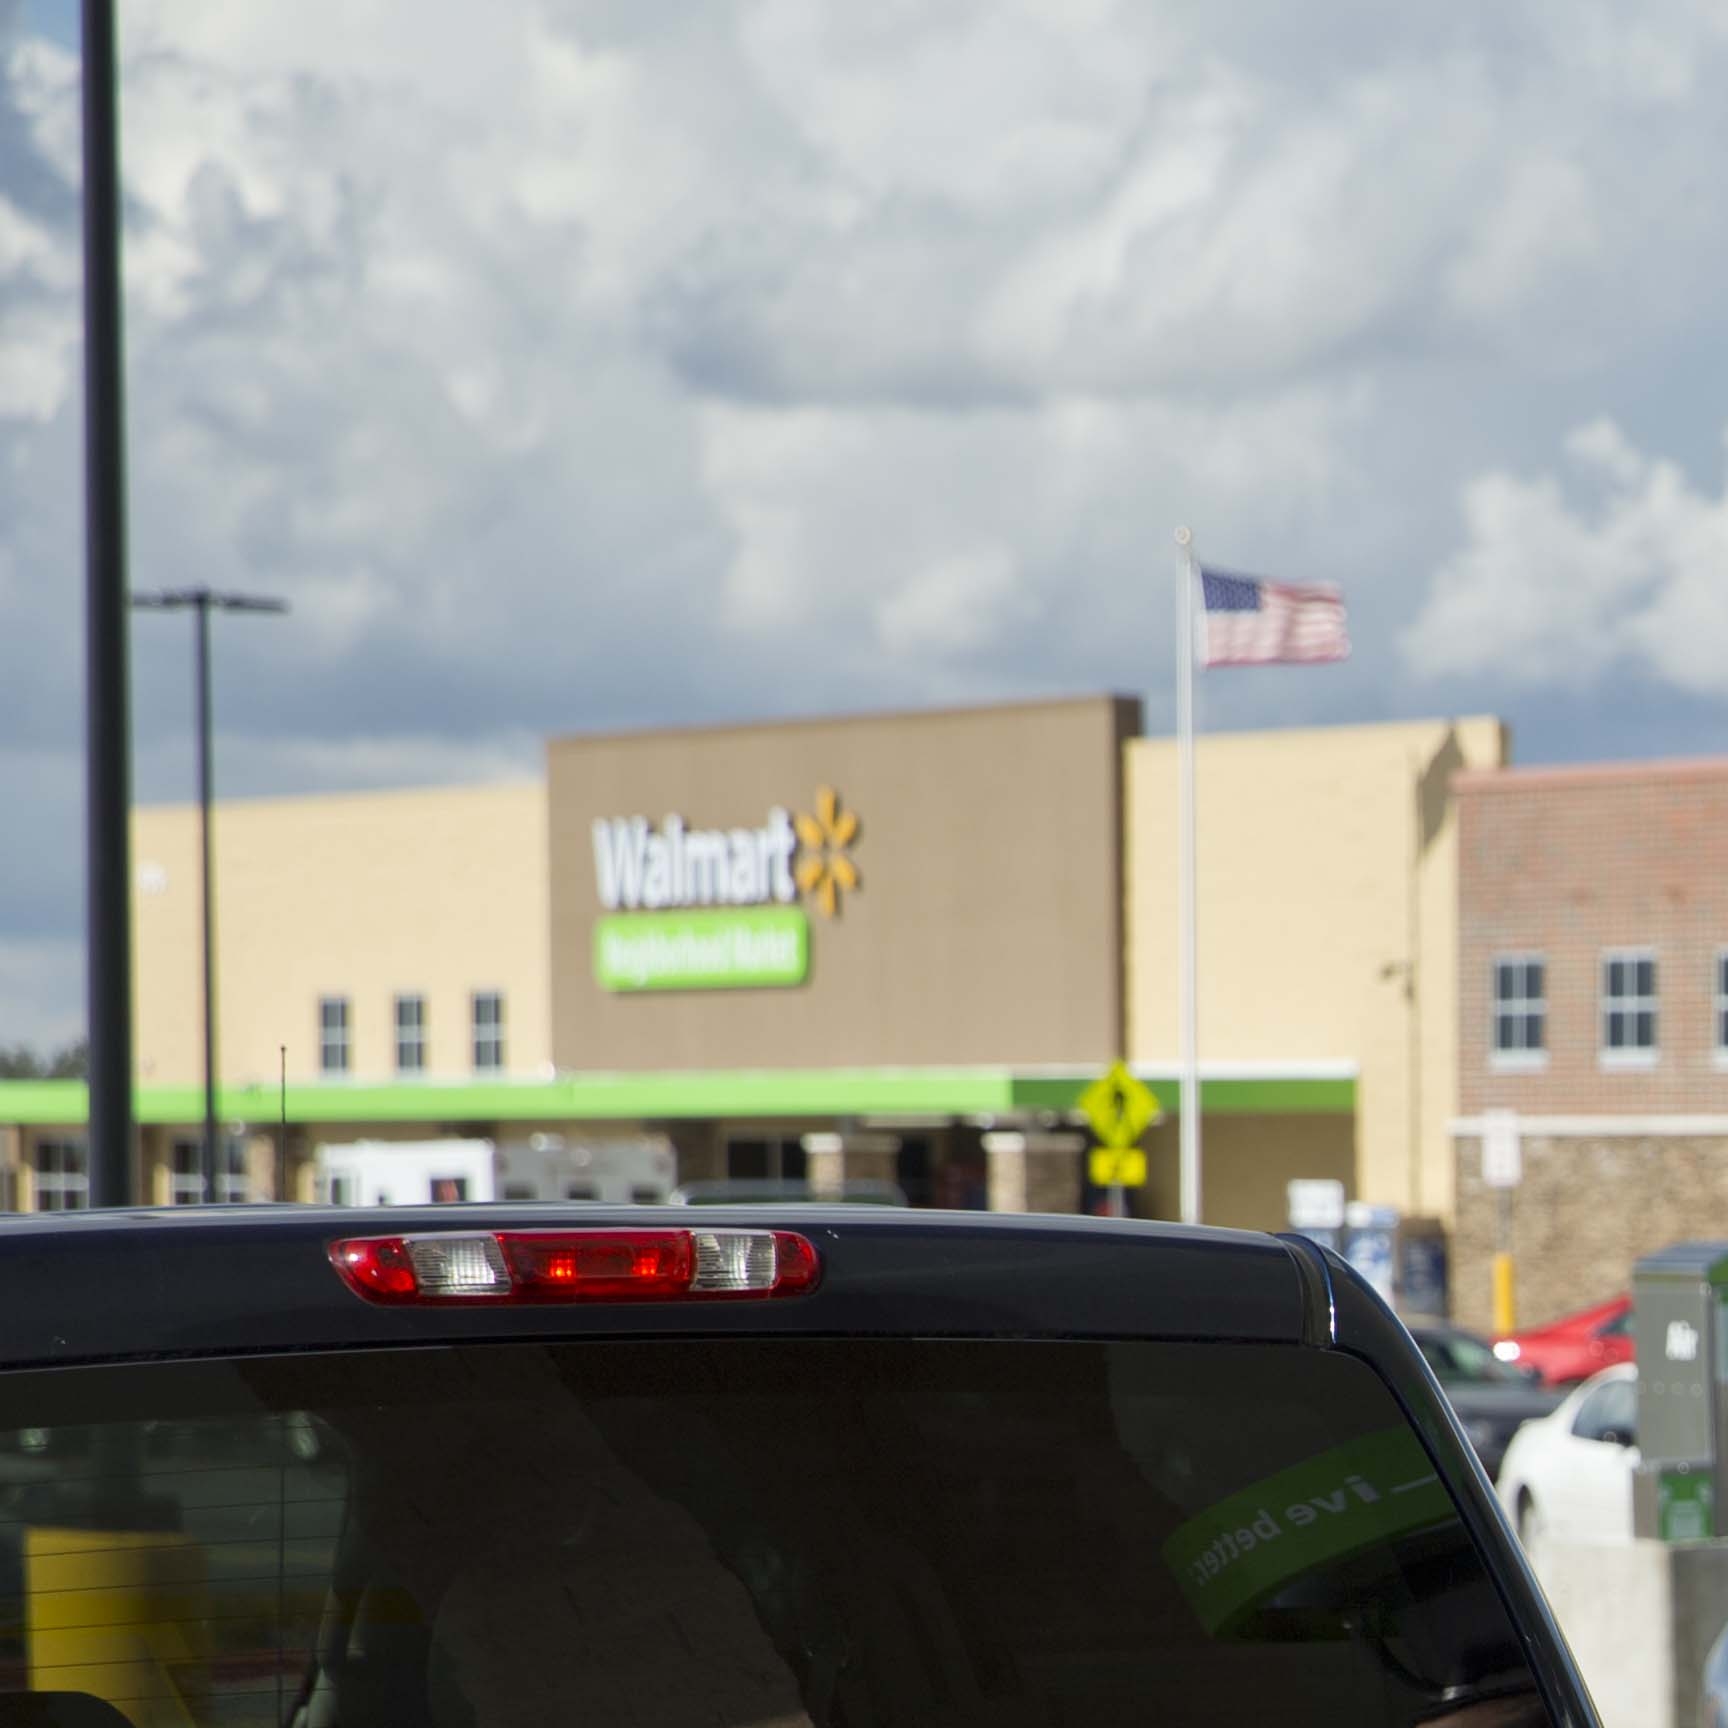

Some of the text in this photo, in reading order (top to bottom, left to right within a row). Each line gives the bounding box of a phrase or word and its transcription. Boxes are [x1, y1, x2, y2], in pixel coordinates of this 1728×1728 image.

[593, 806, 796, 909] Walmart
[734, 922, 799, 974] Market
[1665, 1320, 1698, 1361] Air
